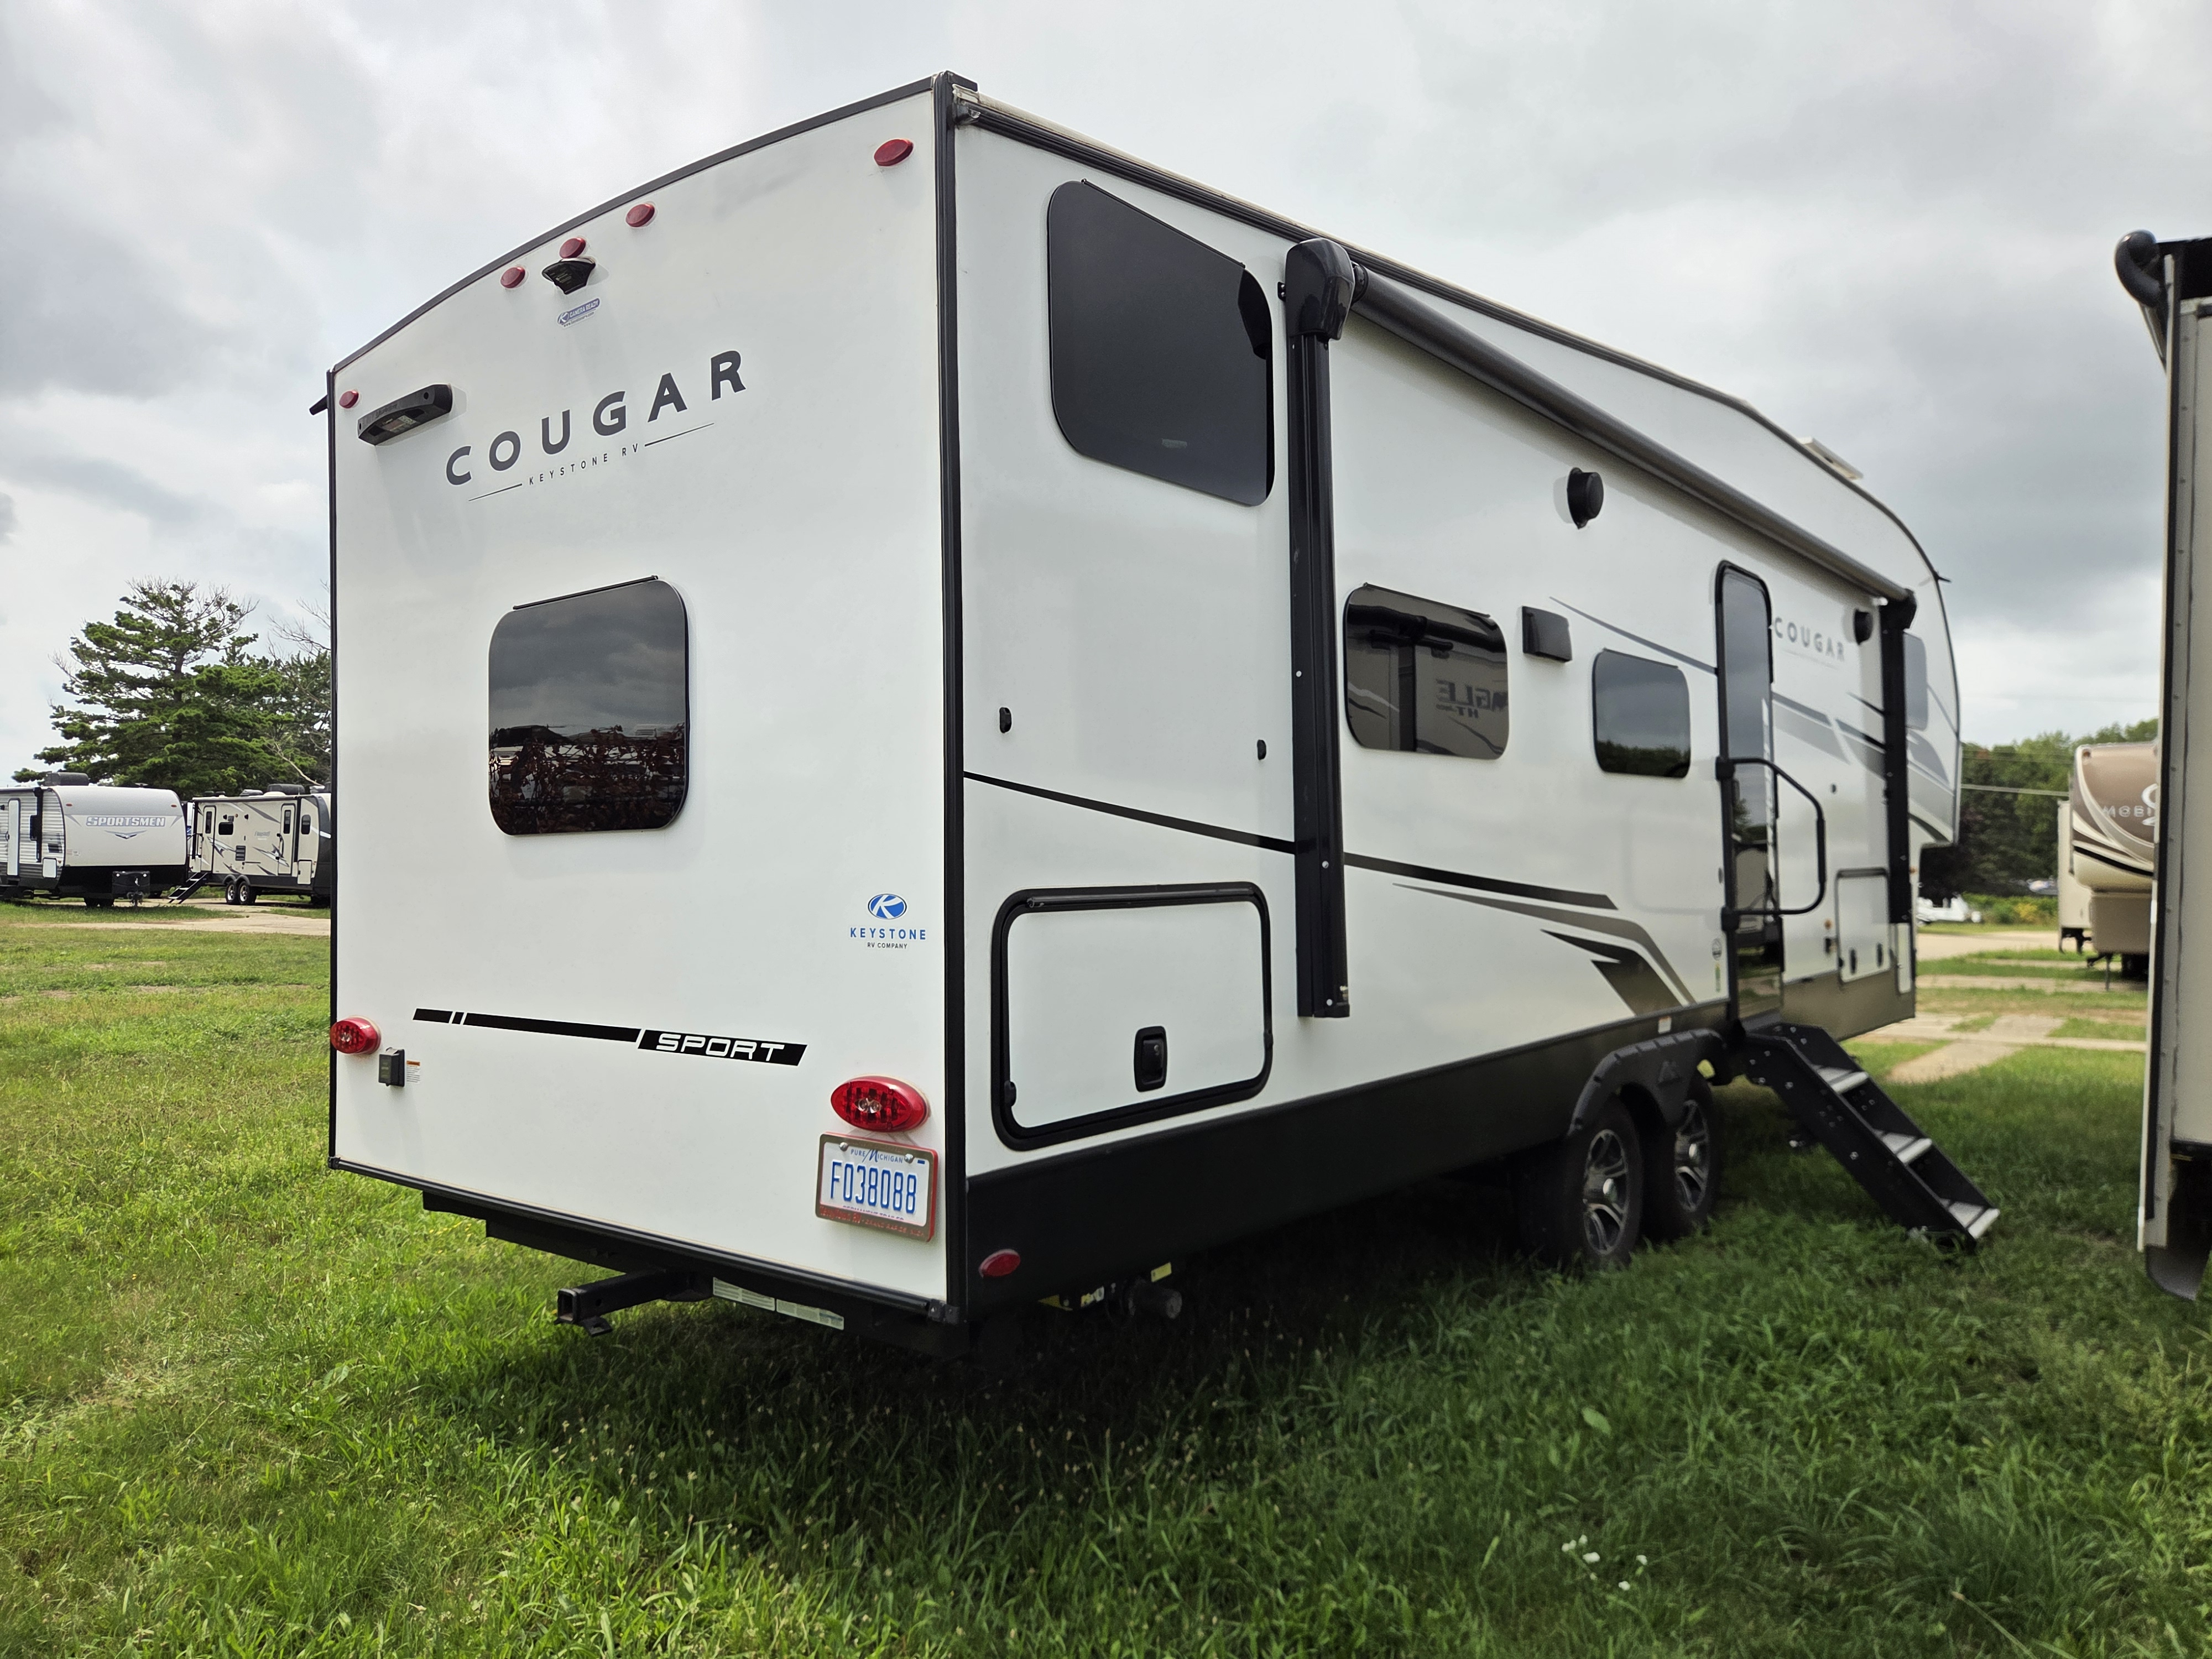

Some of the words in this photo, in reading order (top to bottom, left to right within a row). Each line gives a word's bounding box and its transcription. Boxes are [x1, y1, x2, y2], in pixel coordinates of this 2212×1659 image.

[446, 350, 747, 486] COUGAR
[529, 453, 608, 486] KEYSTONE
[622, 443, 639, 456] RV
[1774, 617, 1844, 662] COUGAR
[86, 815, 166, 827] SPORTSMEN
[850, 927, 926, 940] KEYSTONE
[656, 1033, 785, 1062] SPORT
[851, 1149, 865, 1157] PURE
[862, 1149, 903, 1164] MICHIGAN
[830, 1160, 917, 1214] F038088
